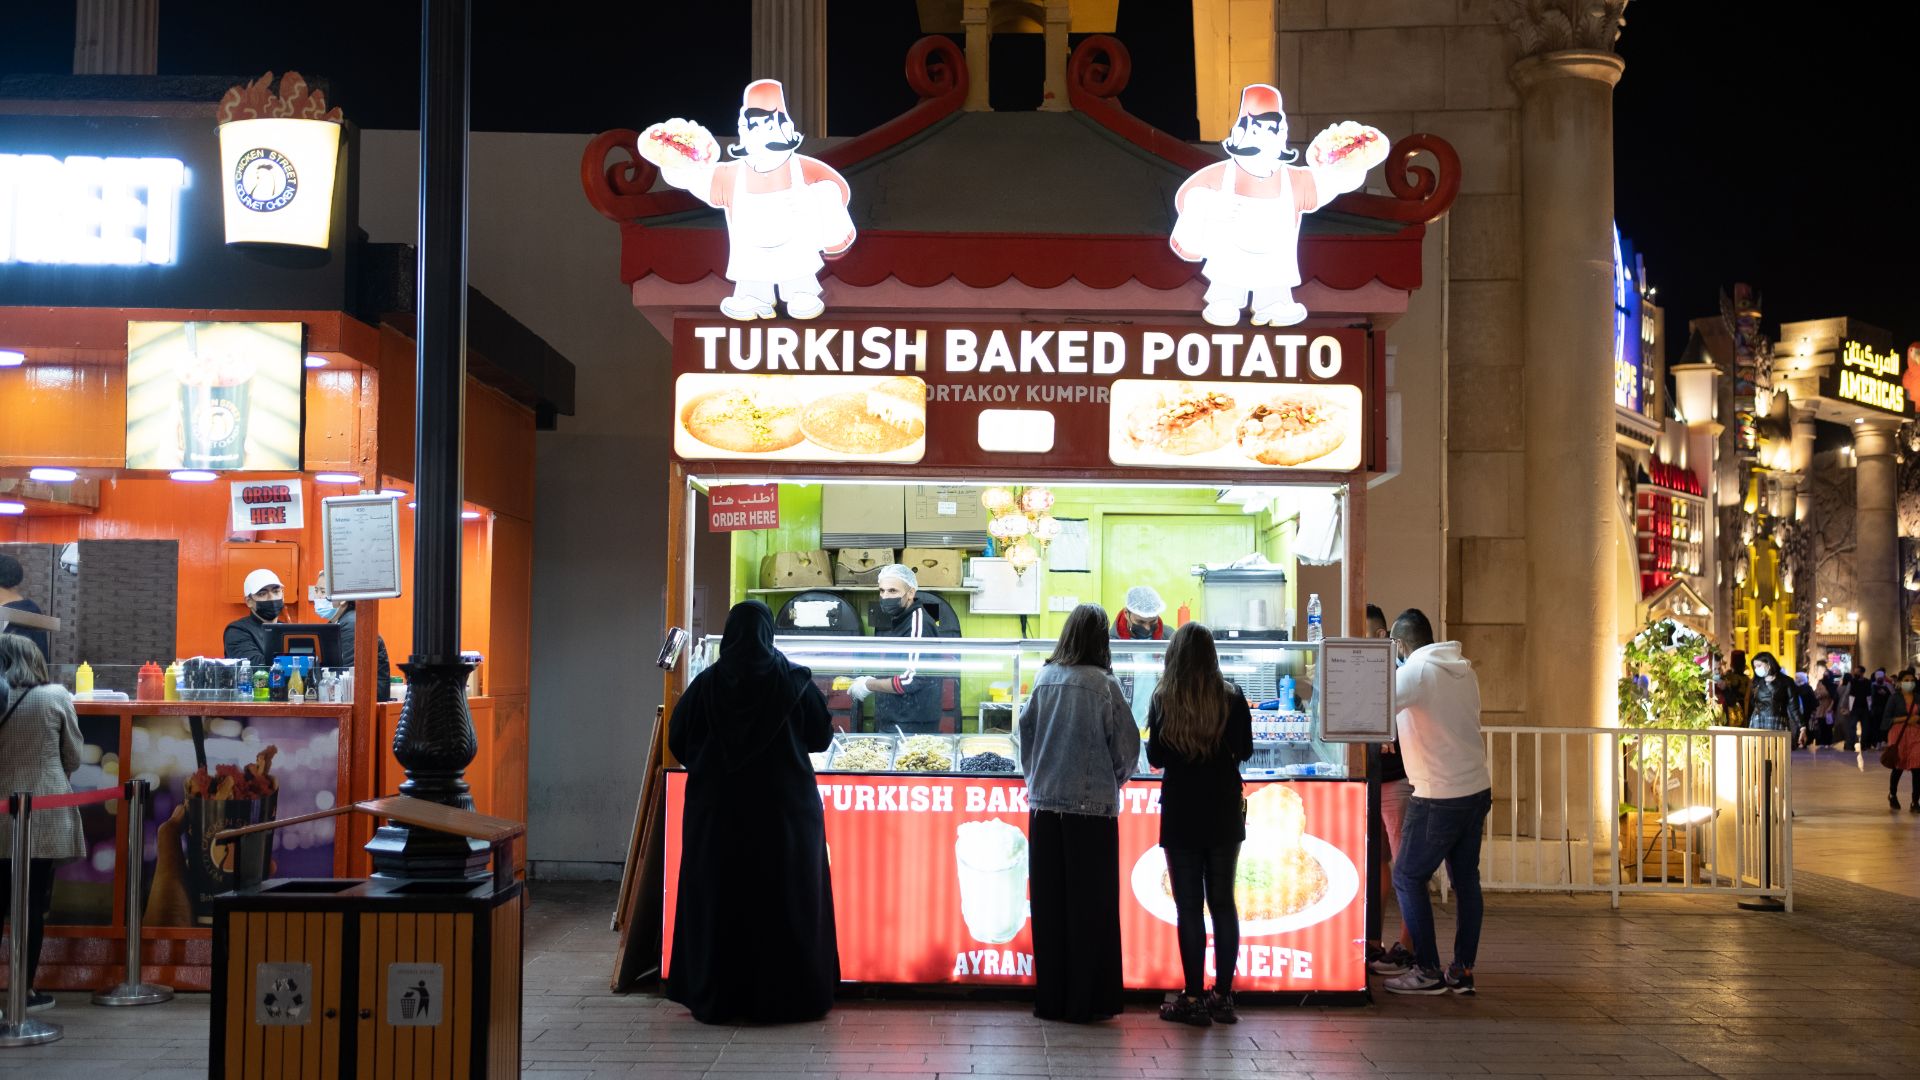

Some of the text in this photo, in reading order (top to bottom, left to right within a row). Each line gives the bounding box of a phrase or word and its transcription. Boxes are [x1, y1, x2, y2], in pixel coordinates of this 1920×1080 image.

[236, 149, 297, 185] CHICKEN STREET
[695, 326, 1342, 379] TURKISH BAKED POTATO
[926, 384, 1110, 403] ORTAKOY KUMPIR
[1839, 369, 1904, 412] AMERICAS
[242, 485, 292, 504] ORDER
[712, 487, 774, 508] أطلب هنا
[250, 506, 286, 525] HERE
[712, 509, 777, 527] ORDER HERE
[817, 785, 1029, 813] TURKISH BAK
[953, 949, 1033, 976] AYRAN
[1205, 939, 1313, 979] NEFE
